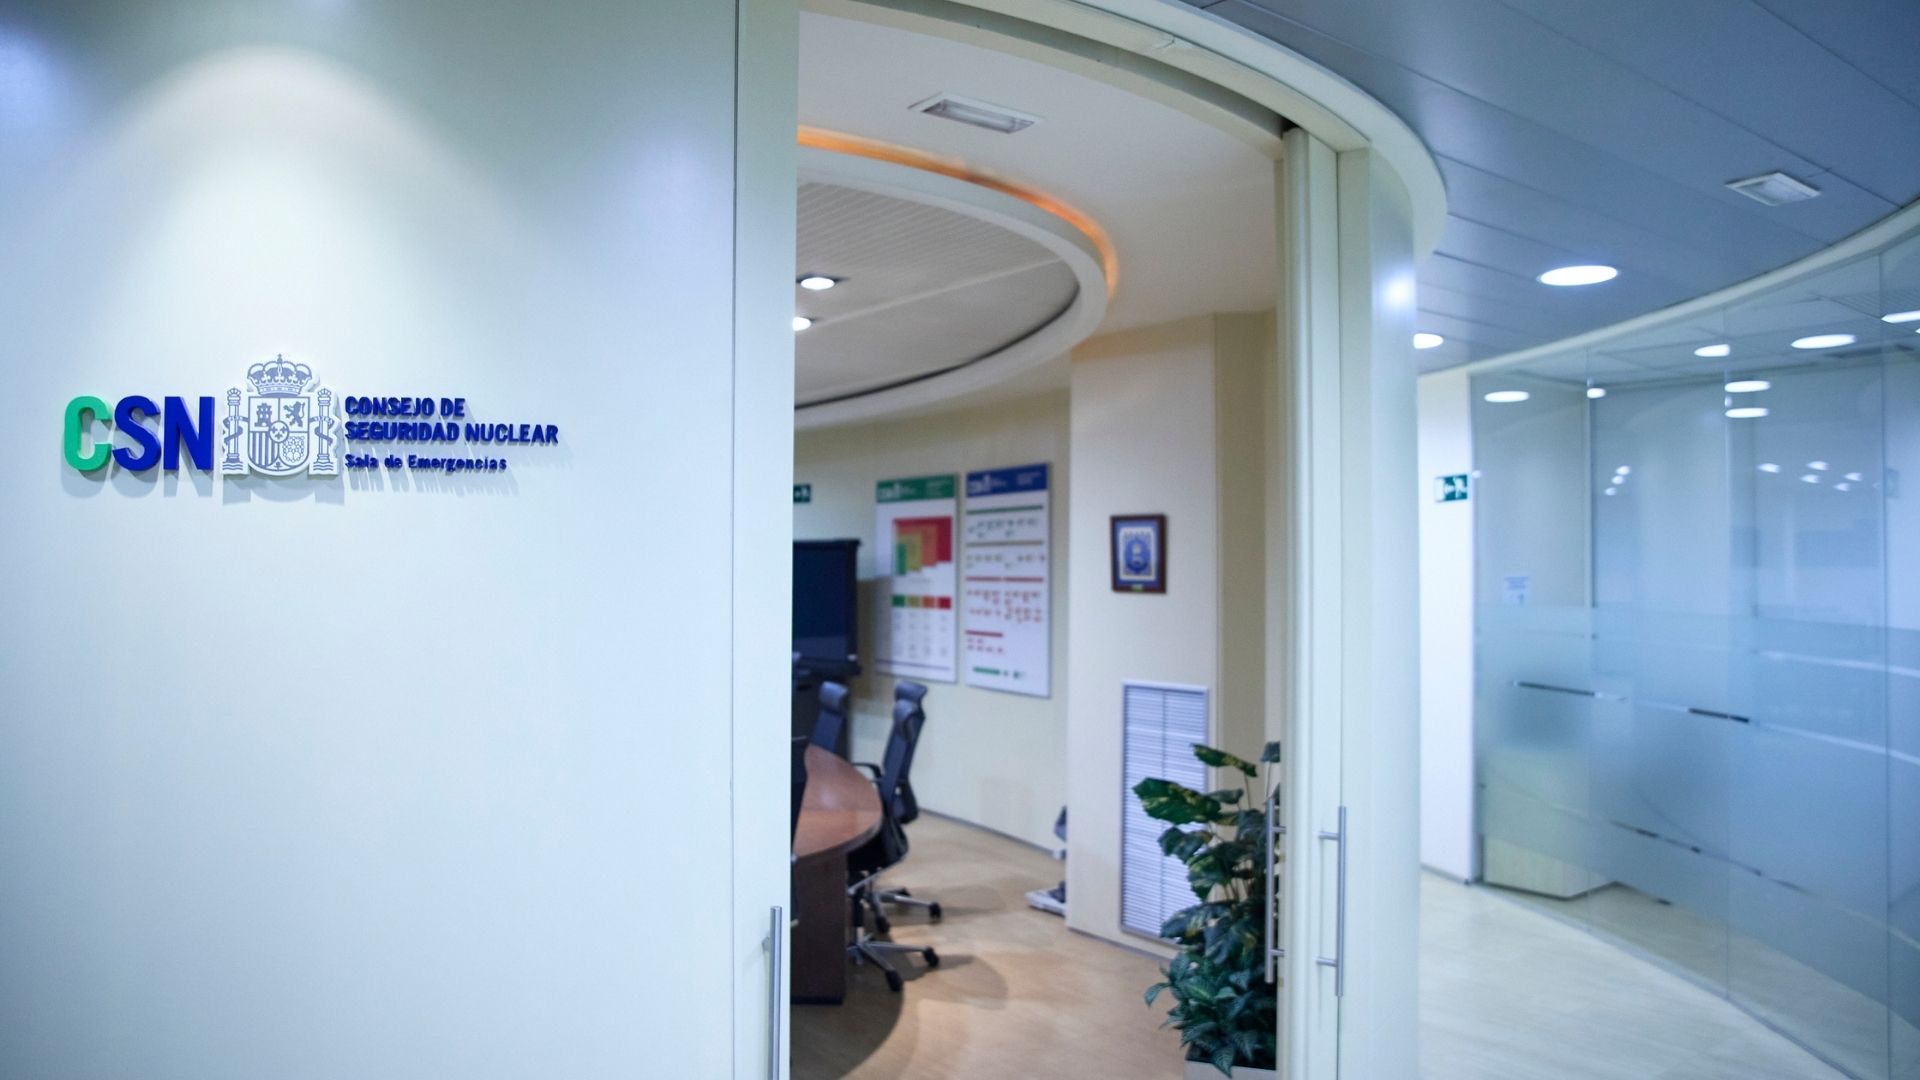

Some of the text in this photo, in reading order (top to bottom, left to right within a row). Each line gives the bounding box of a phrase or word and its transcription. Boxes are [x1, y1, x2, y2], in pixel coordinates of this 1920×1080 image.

[344, 396, 466, 418] CONSEJO DE
[63, 395, 215, 471] CSN
[344, 421, 559, 444] SEGURIDAD NUCLEAR
[344, 453, 508, 473] Sala de Emergencias
